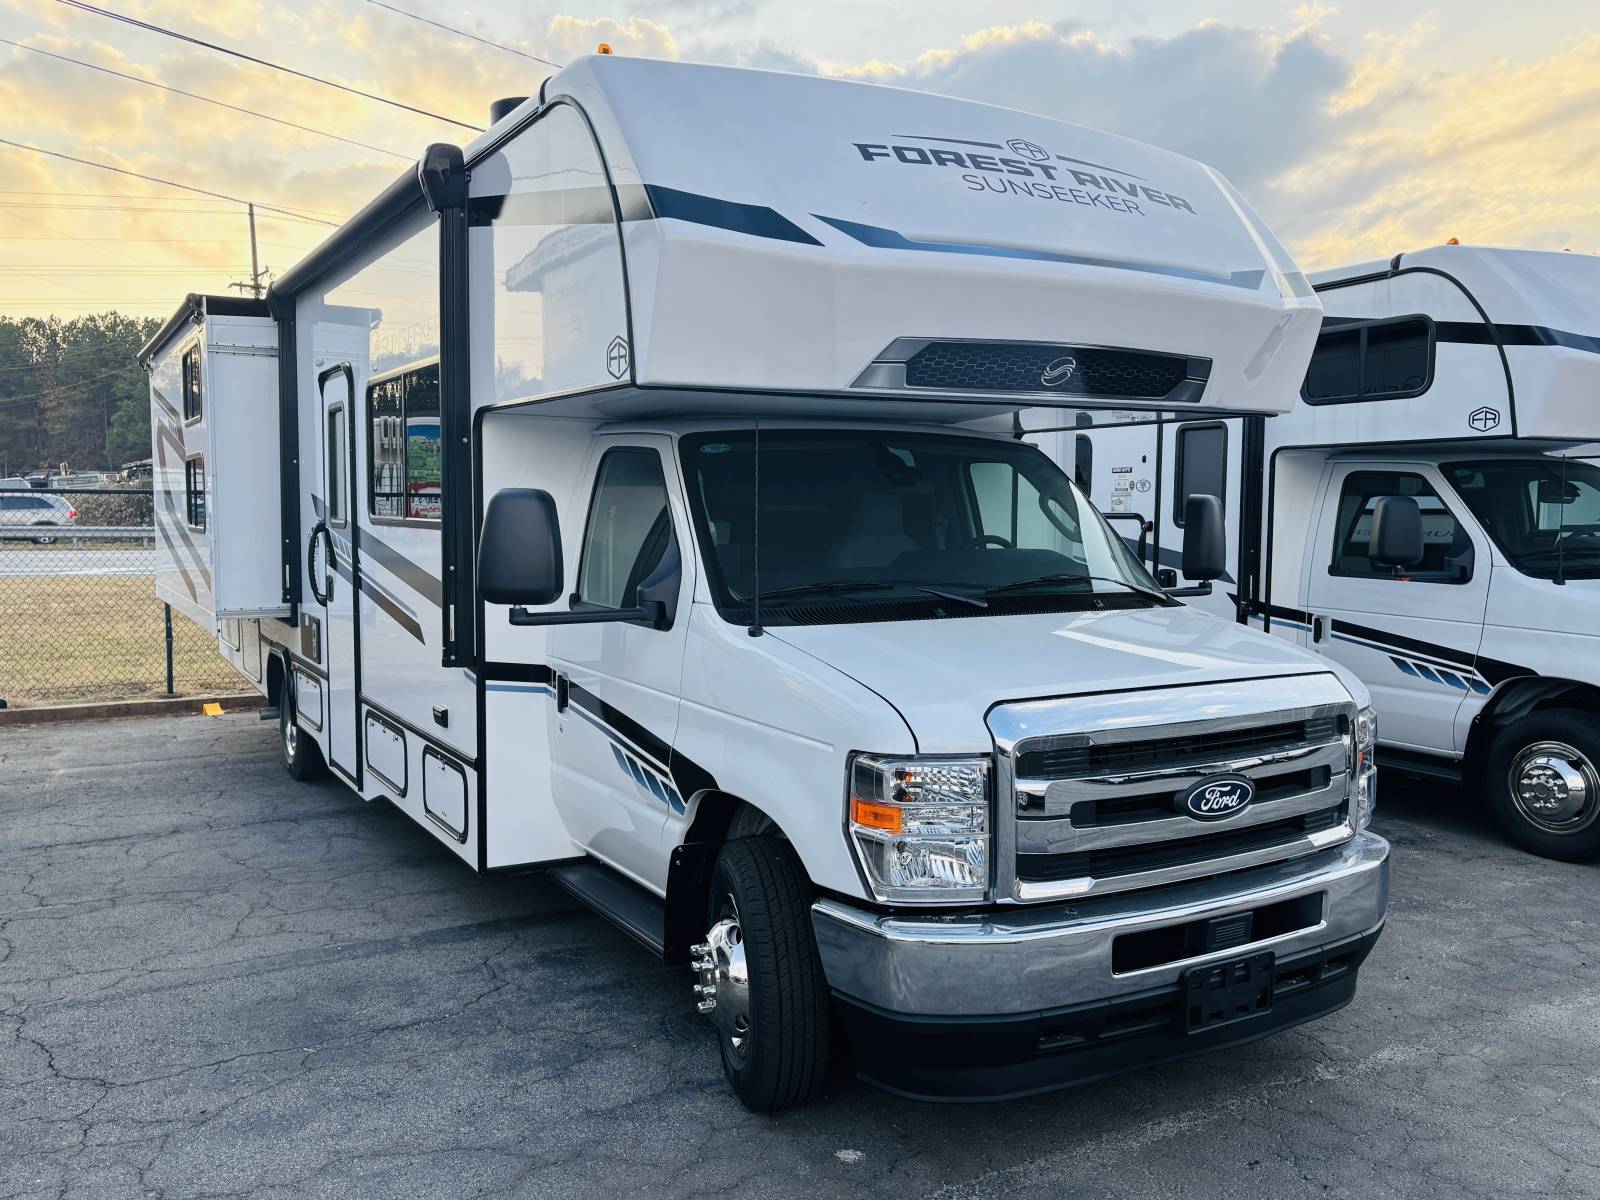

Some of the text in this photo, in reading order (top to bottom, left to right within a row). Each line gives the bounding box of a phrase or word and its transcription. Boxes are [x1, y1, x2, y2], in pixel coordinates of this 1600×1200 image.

[851, 142, 1199, 215] FOREST RIVER
[961, 173, 1146, 217] SUNSEEKER
[1471, 409, 1498, 429] FR
[1200, 785, 1241, 811] Ford
